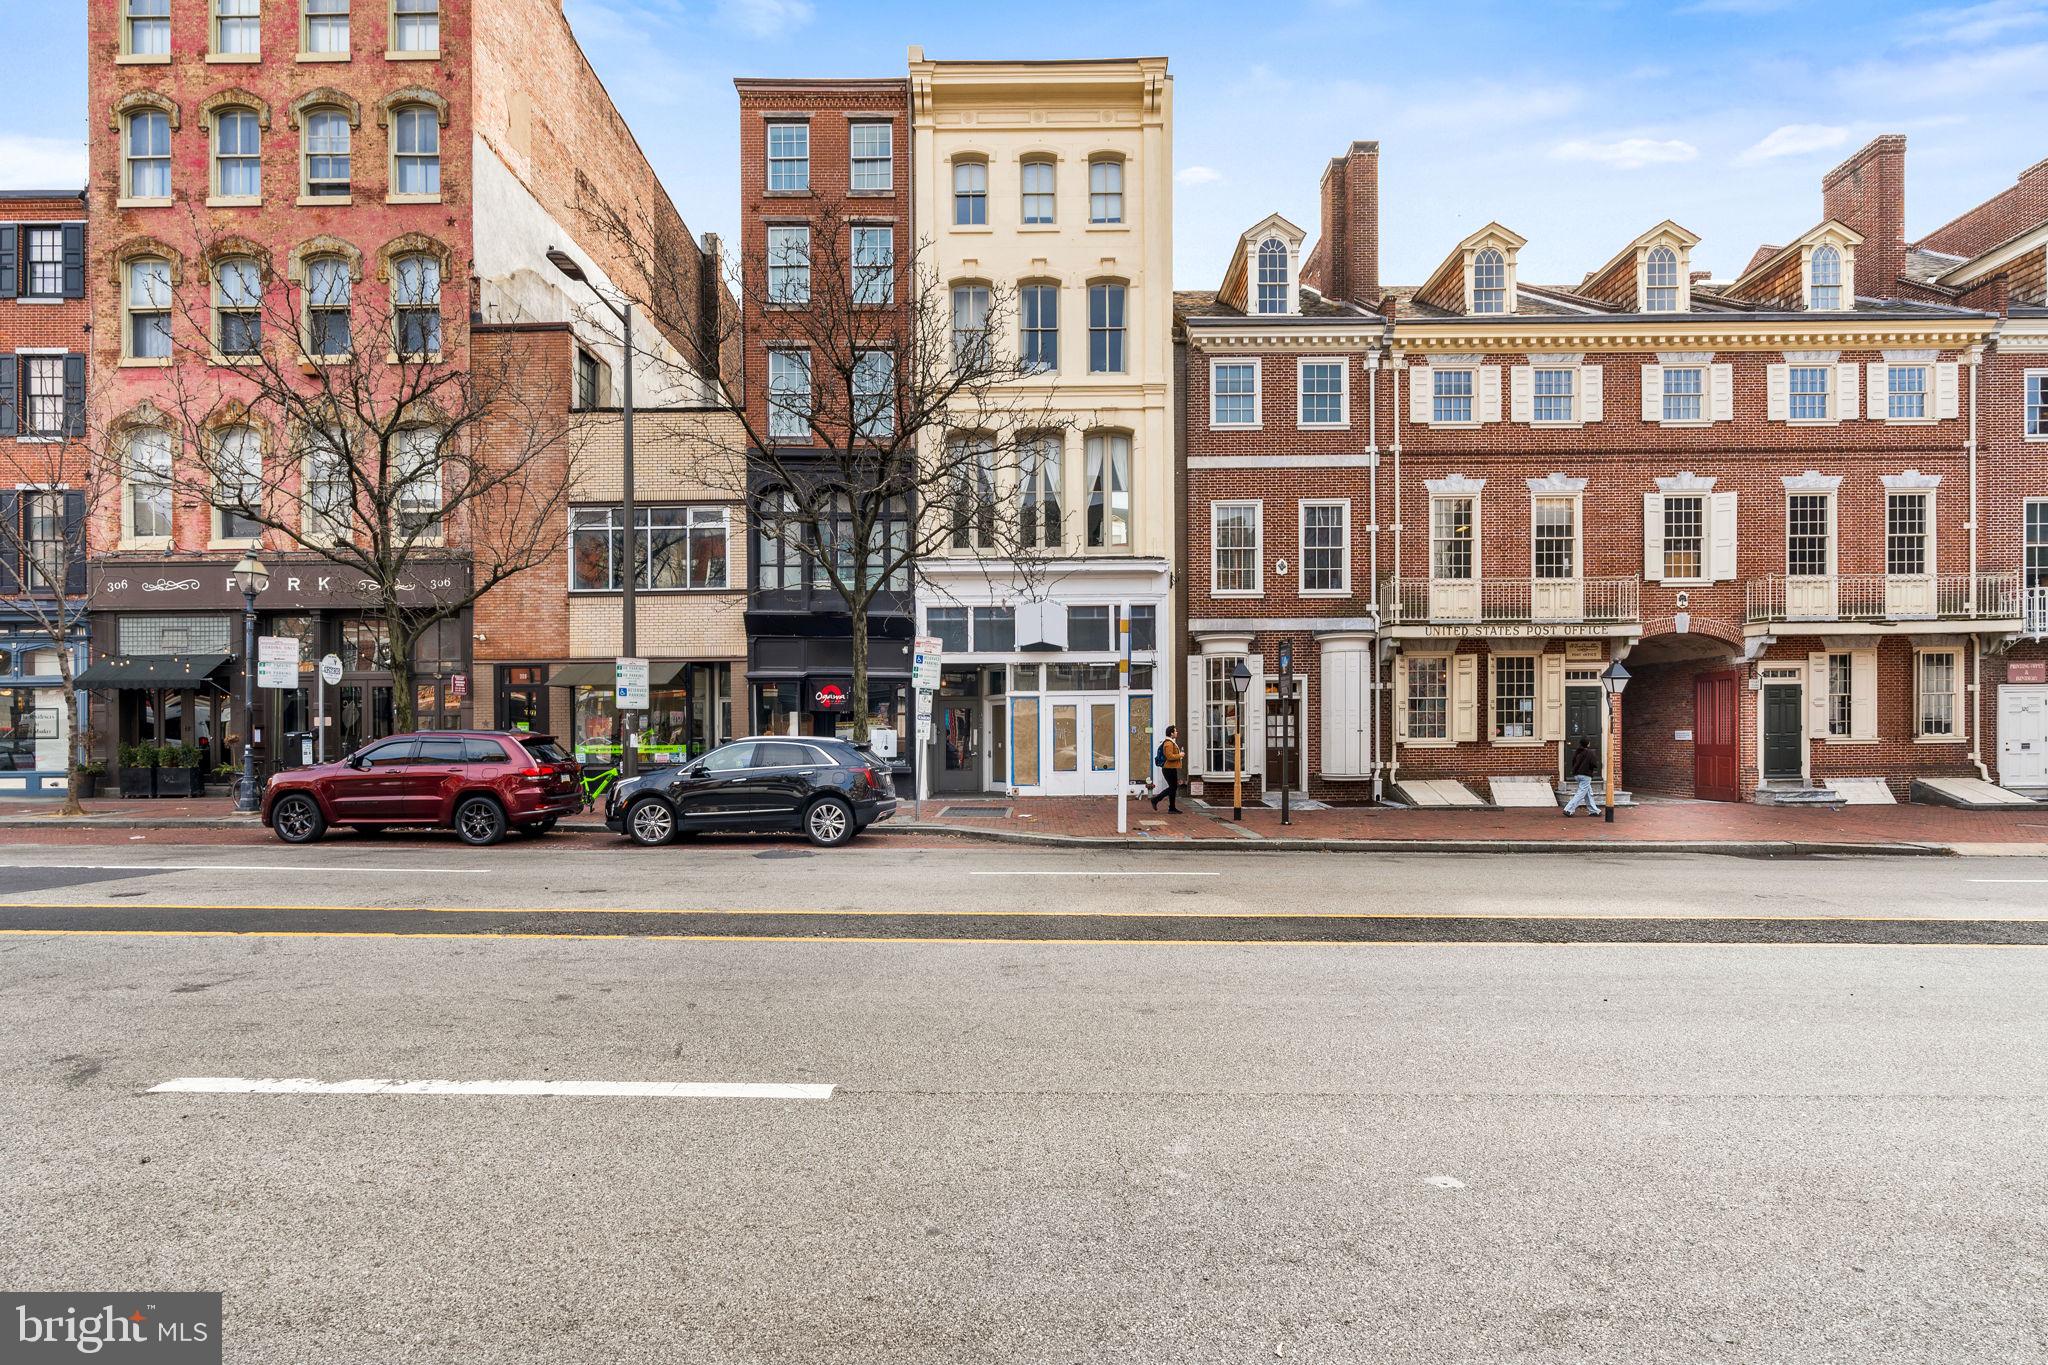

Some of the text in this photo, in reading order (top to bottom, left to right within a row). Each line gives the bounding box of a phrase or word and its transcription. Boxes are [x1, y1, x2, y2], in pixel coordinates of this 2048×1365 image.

[107, 579, 128, 592] 306
[226, 576, 331, 592] FORK
[430, 578, 451, 590] 306
[1425, 626, 1609, 636] UNITED STATES POST OFFICE
[815, 691, 846, 704] Ogawa
